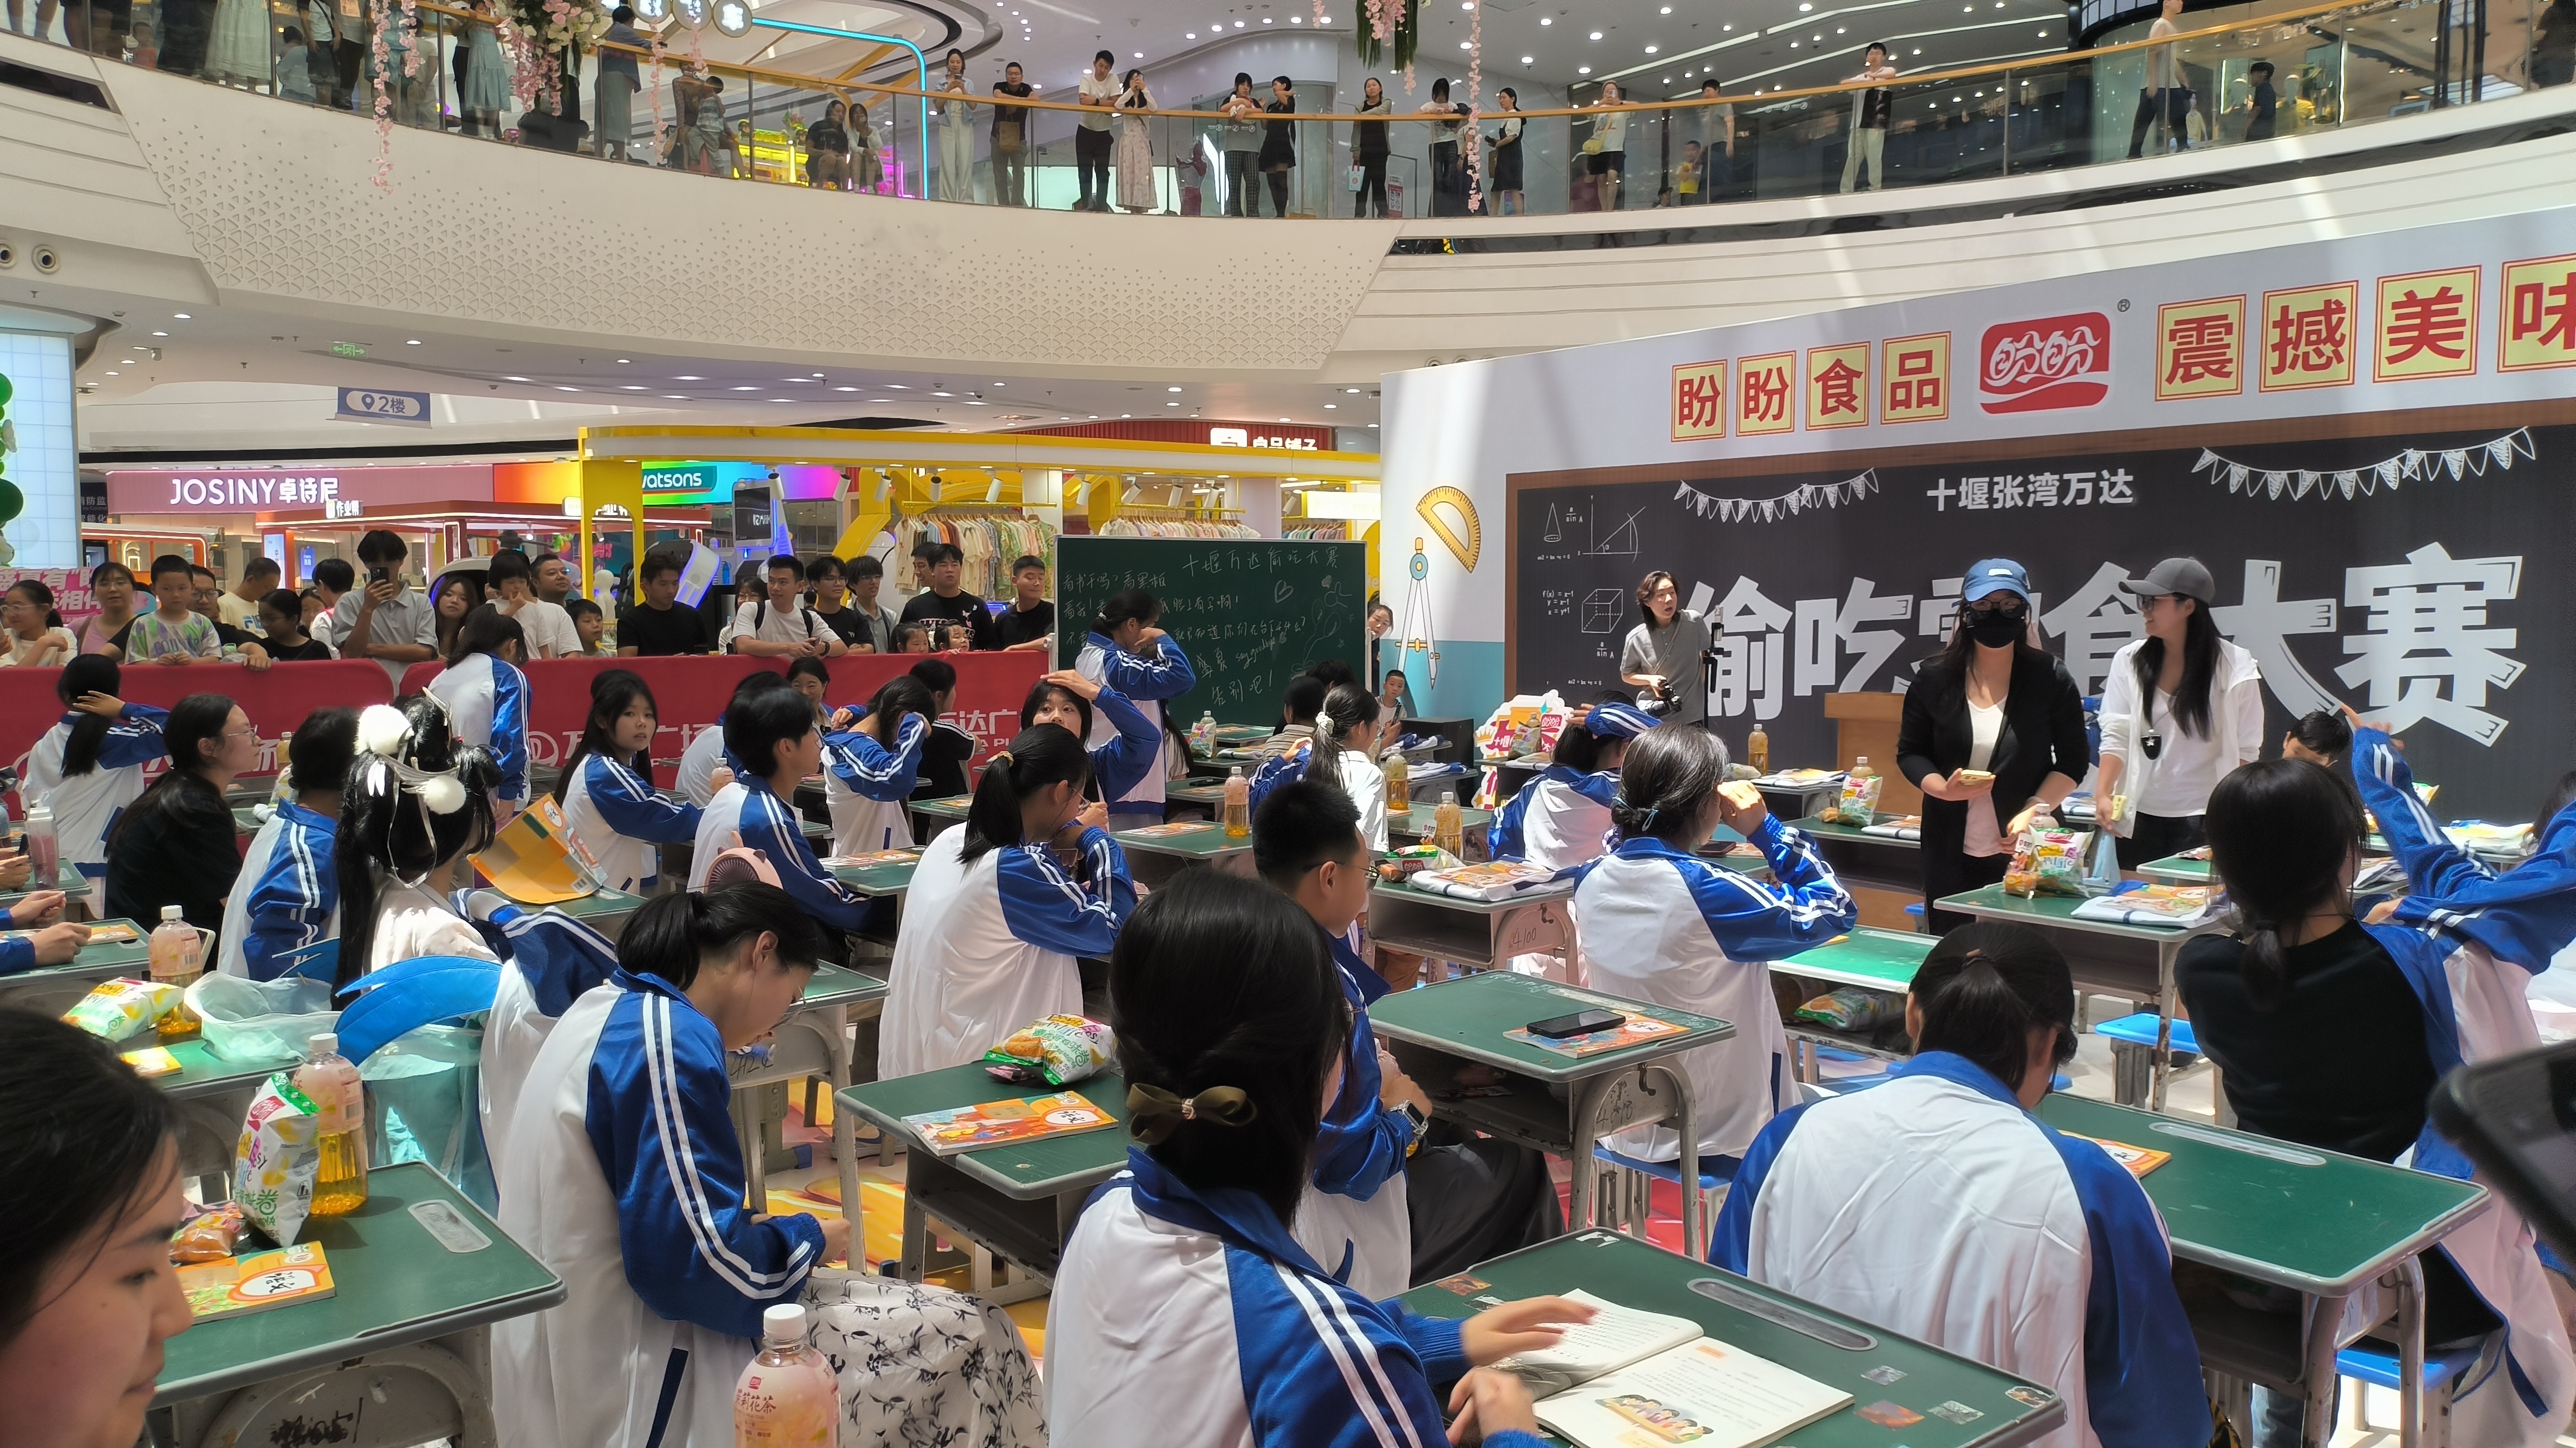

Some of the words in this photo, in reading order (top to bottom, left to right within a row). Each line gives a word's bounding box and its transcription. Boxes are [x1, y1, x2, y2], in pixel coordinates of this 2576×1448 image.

[2165, 272, 2576, 385] 震撼美味
[378, 396, 406, 414] 2楼
[1678, 349, 1941, 429] 盼盼食品
[170, 478, 276, 505] JOSINY
[279, 477, 339, 504] 卓诗尼
[1927, 469, 2135, 512] 十堰张湾万达
[1684, 542, 2526, 747] 偷吃食大赛
